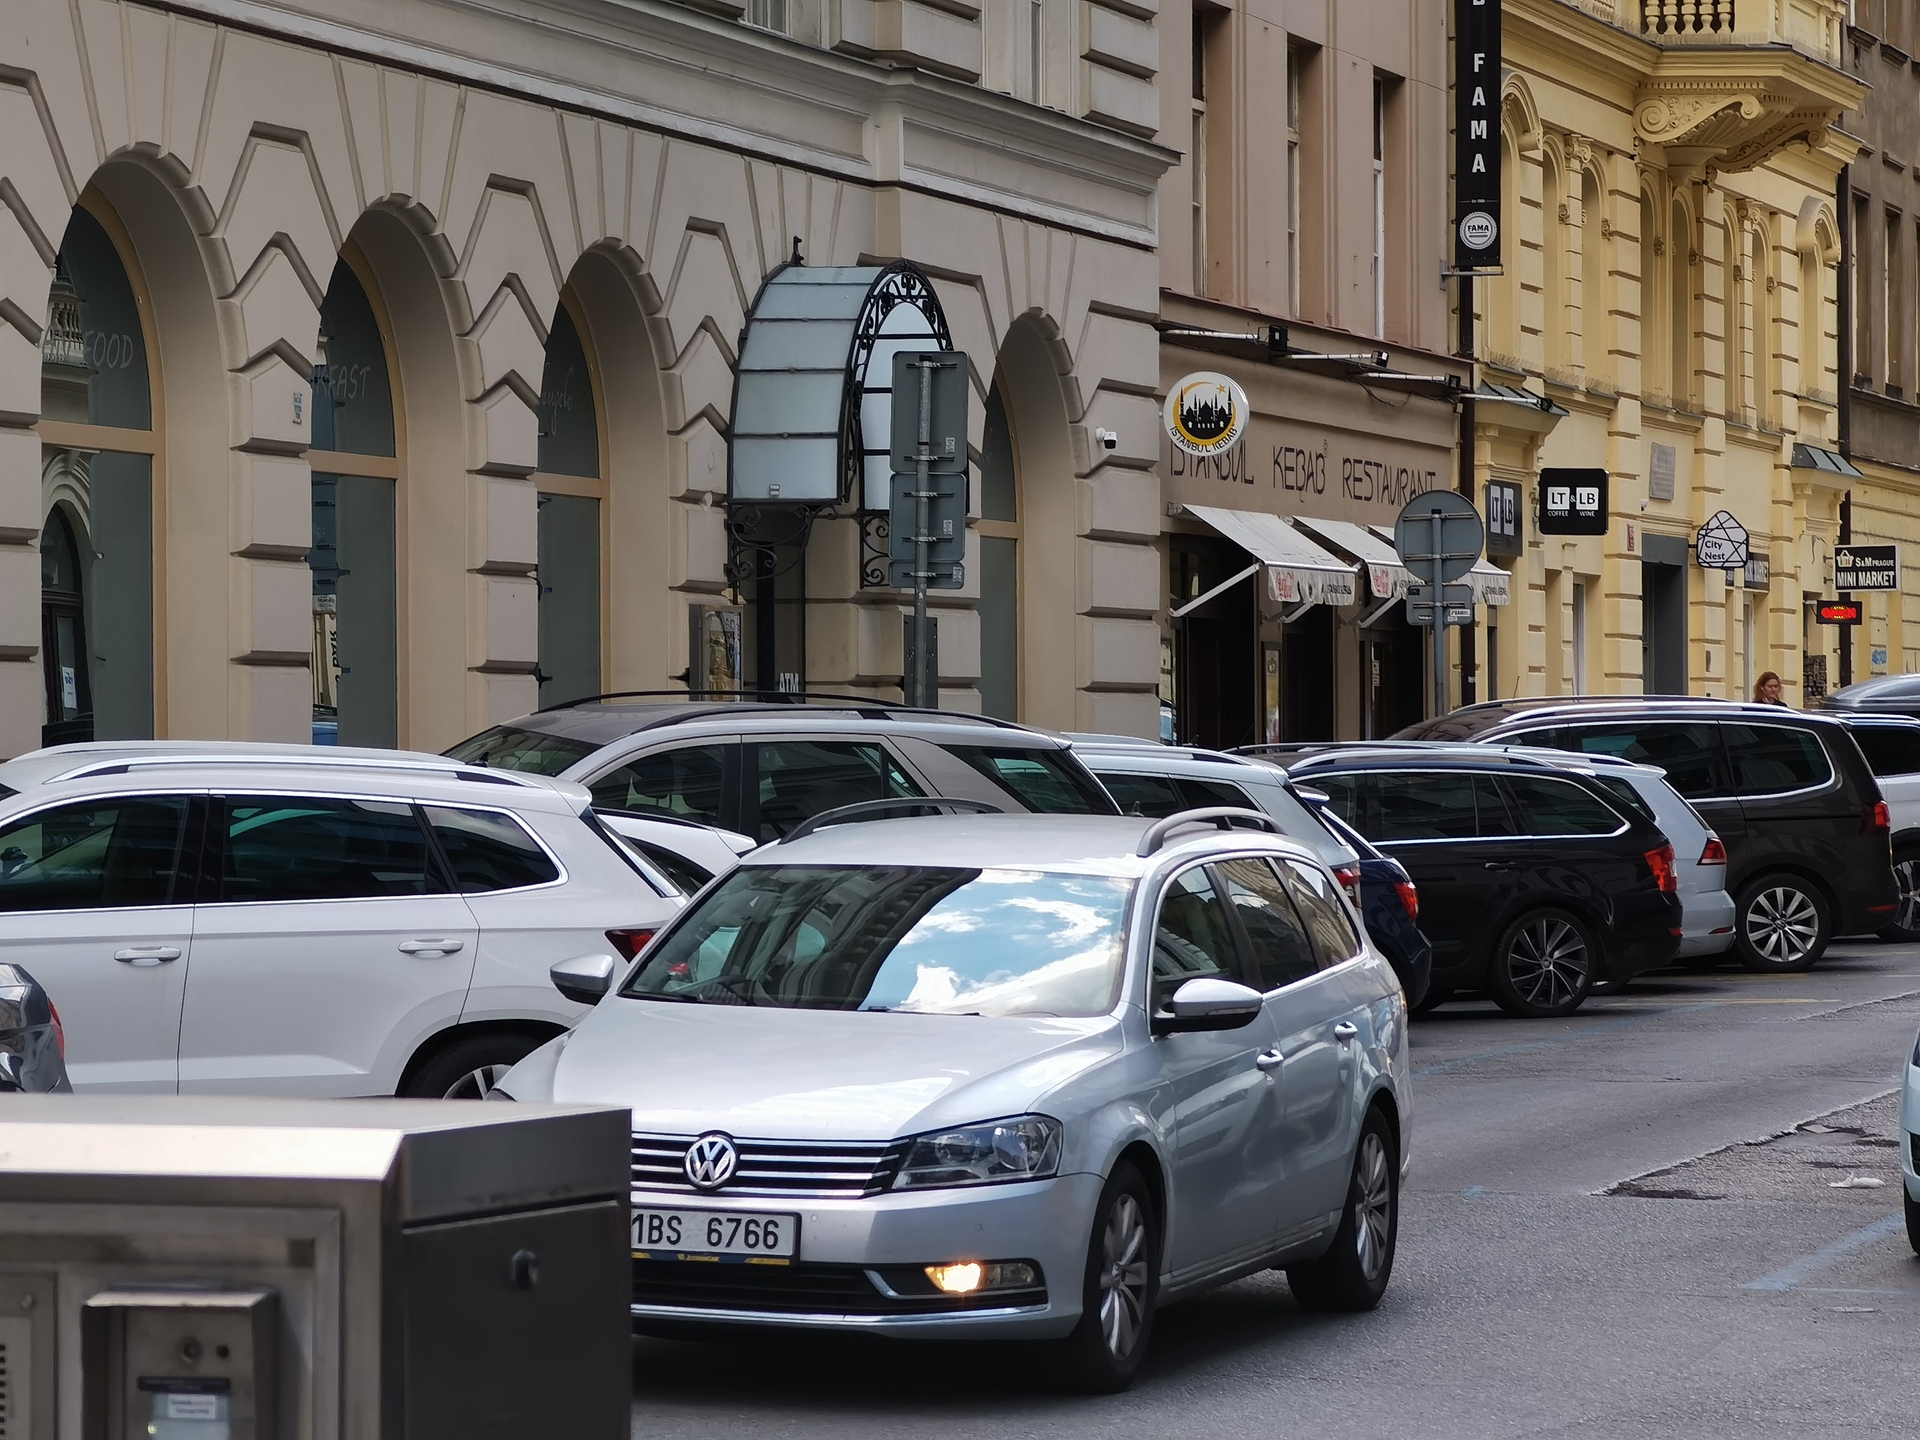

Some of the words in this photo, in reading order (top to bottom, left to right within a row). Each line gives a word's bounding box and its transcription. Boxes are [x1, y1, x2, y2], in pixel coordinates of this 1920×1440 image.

[1471, 53, 1487, 173] FAMA
[84, 330, 133, 369] FOOD
[312, 364, 371, 399] KFAST
[1170, 426, 1211, 453] ISTANBUL
[1212, 427, 1238, 451] KEBAB
[1273, 446, 1326, 495] KEBAB
[1550, 492, 1566, 505] LT
[1570, 494, 1577, 503] &
[1579, 492, 1596, 505] LB
[1704, 552, 1725, 560] Nest
[1705, 541, 1723, 550] City
[1837, 571, 1856, 587] MINI
[1858, 571, 1895, 586] MARKET
[779, 673, 799, 693] ATM
[632, 1213, 682, 1245] 1BS
[706, 1217, 779, 1250] 6766
